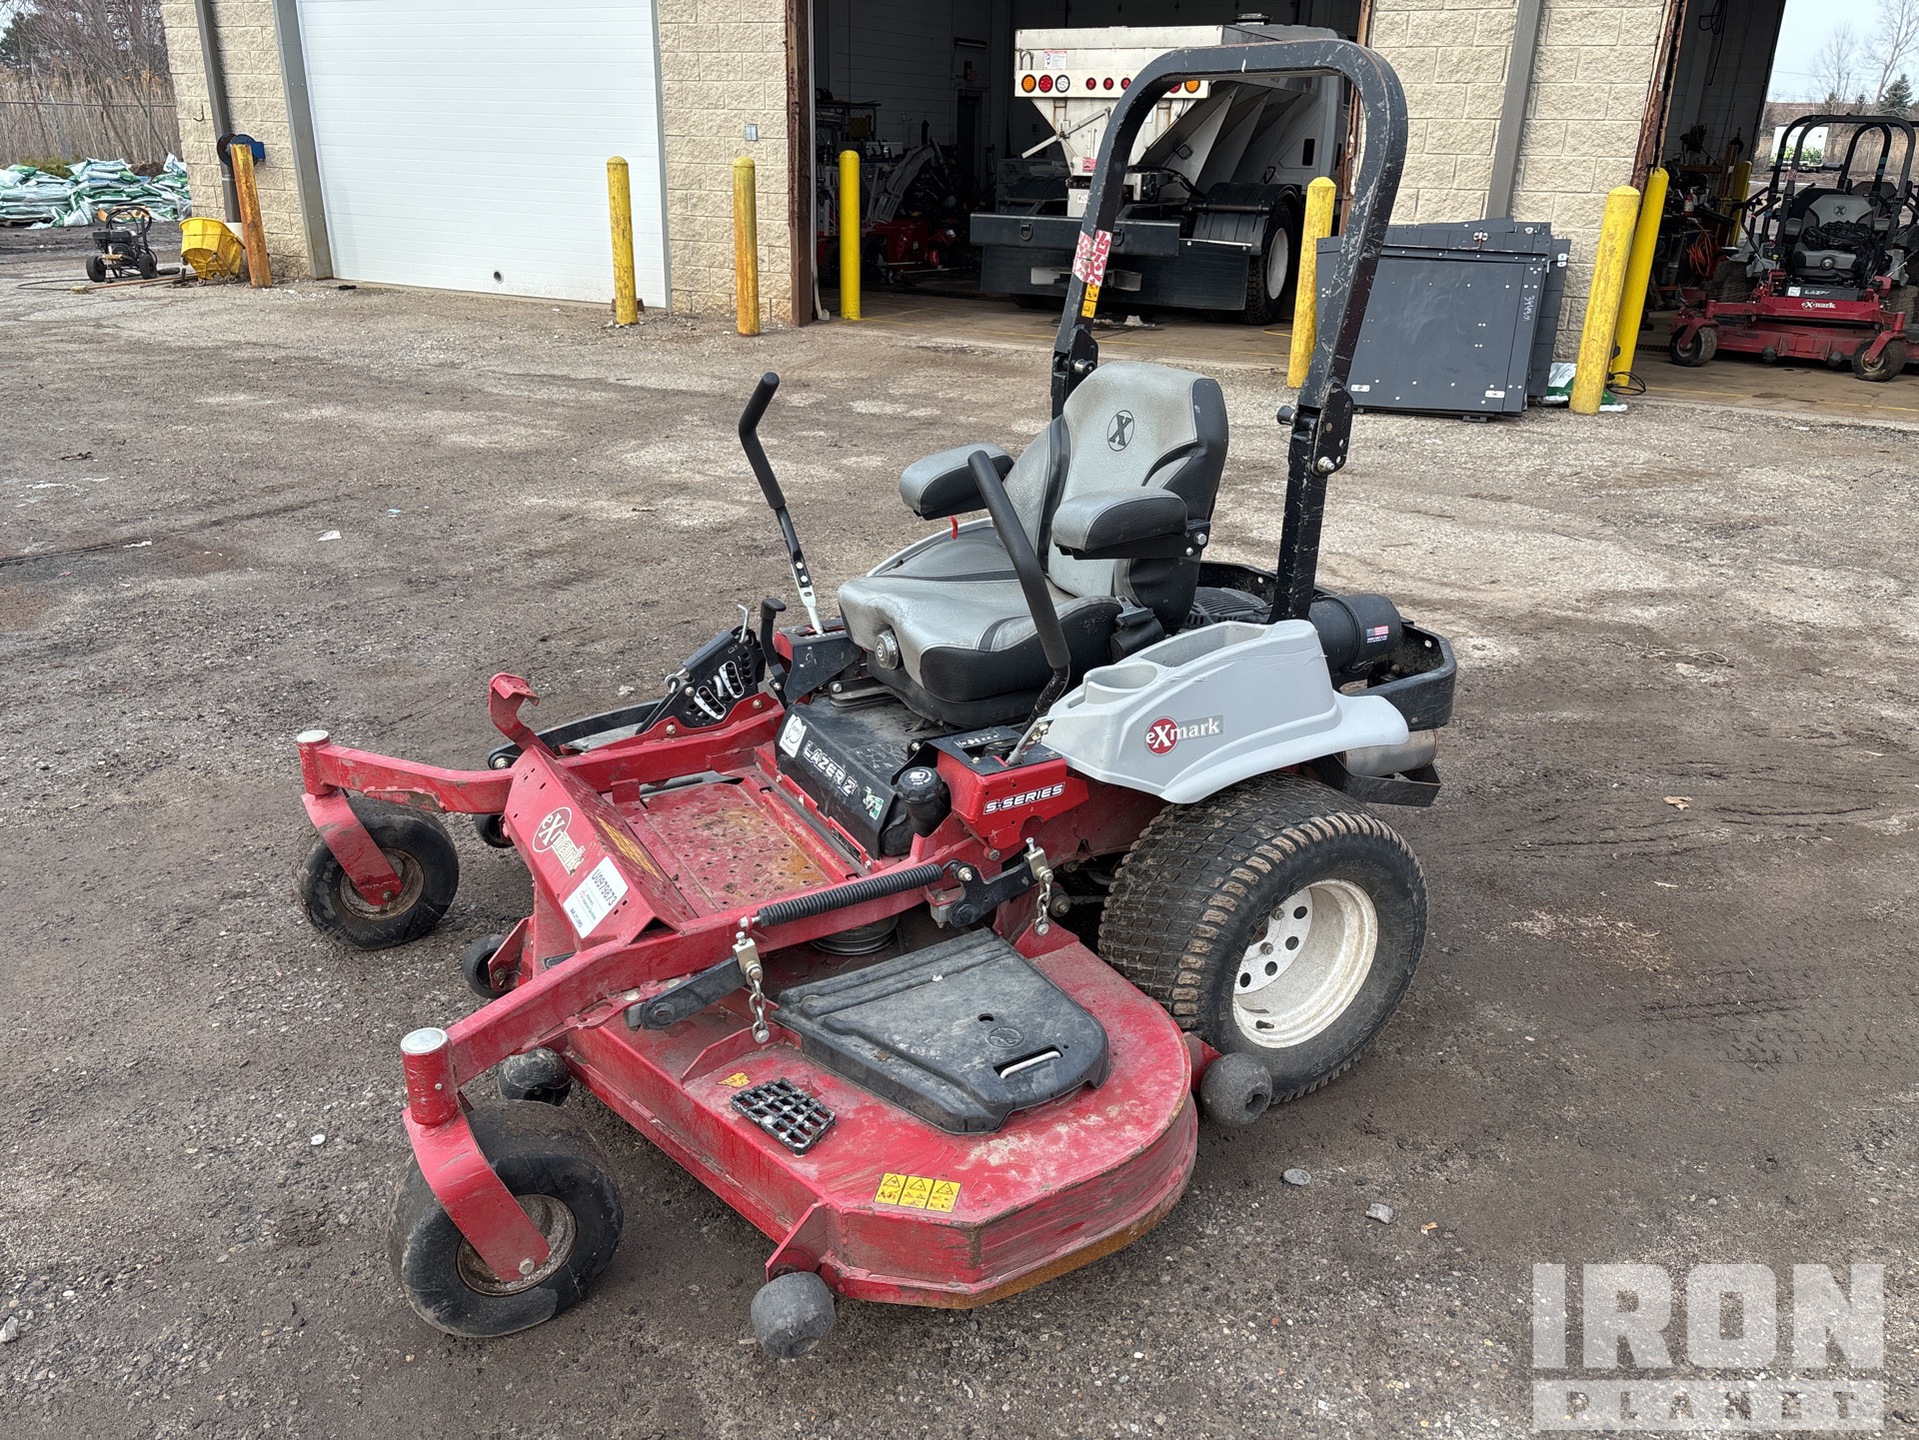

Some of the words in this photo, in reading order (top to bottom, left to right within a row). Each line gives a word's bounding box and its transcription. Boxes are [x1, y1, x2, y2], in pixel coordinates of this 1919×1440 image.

[1145, 717, 1221, 749] eXmark
[984, 783, 1064, 814] S-SERIES
[538, 812, 585, 874] eXmark
[591, 869, 618, 906] U0979873
